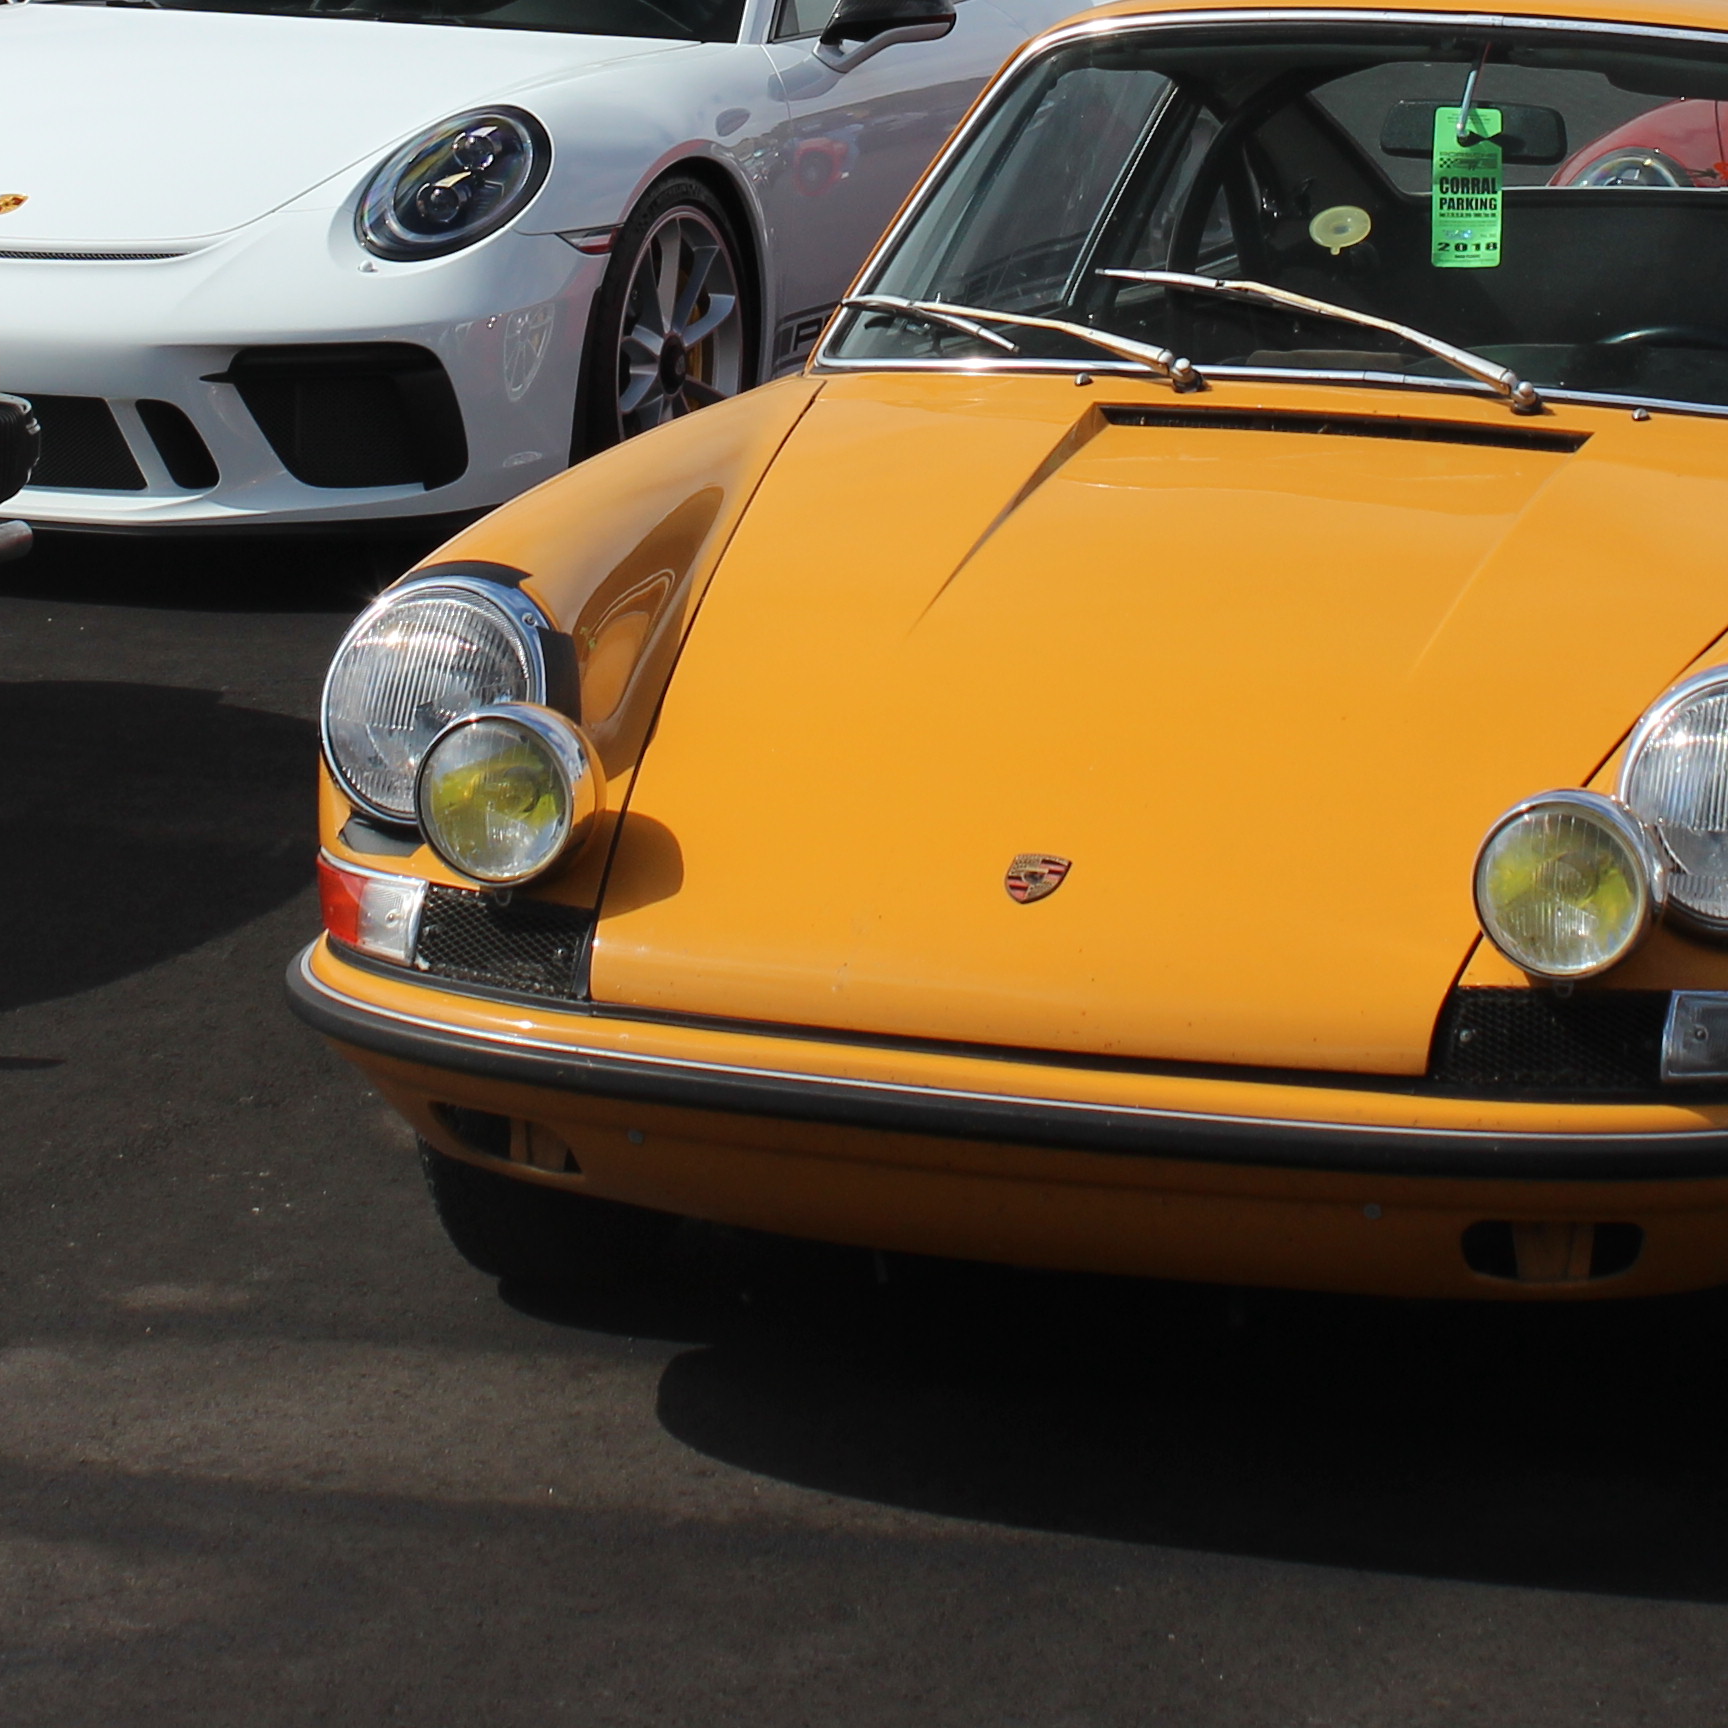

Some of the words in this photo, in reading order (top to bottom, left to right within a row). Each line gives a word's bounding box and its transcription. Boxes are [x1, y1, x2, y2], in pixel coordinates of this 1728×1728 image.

[1440, 176, 1497, 194] CORRAL
[1440, 198, 1497, 210] PARKING
[1437, 242, 1497, 252] 2018
